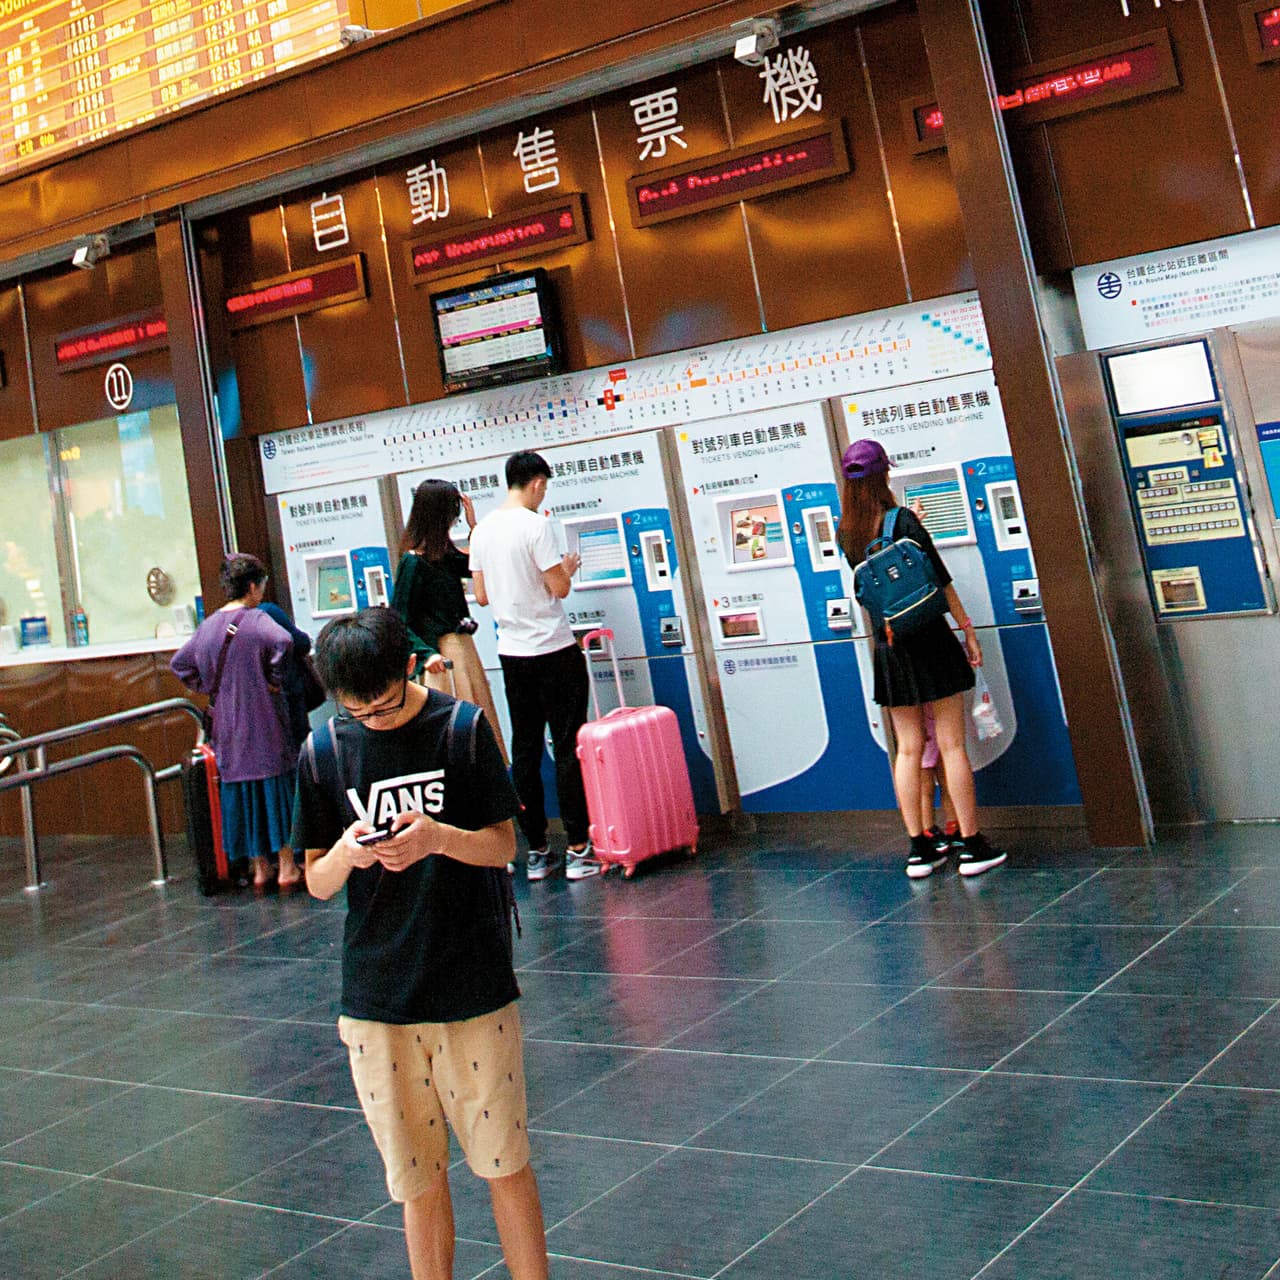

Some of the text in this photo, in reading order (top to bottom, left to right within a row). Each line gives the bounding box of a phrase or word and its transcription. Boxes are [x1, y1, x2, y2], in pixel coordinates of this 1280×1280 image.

[309, 45, 823, 253] 自動售票機
[861, 389, 991, 427] 對號列車自動售票機
[871, 411, 985, 437] TICKETS VENDING MACHINE
[691, 421, 807, 455] 對號列車自動售票機
[346, 769, 445, 829] VANS
